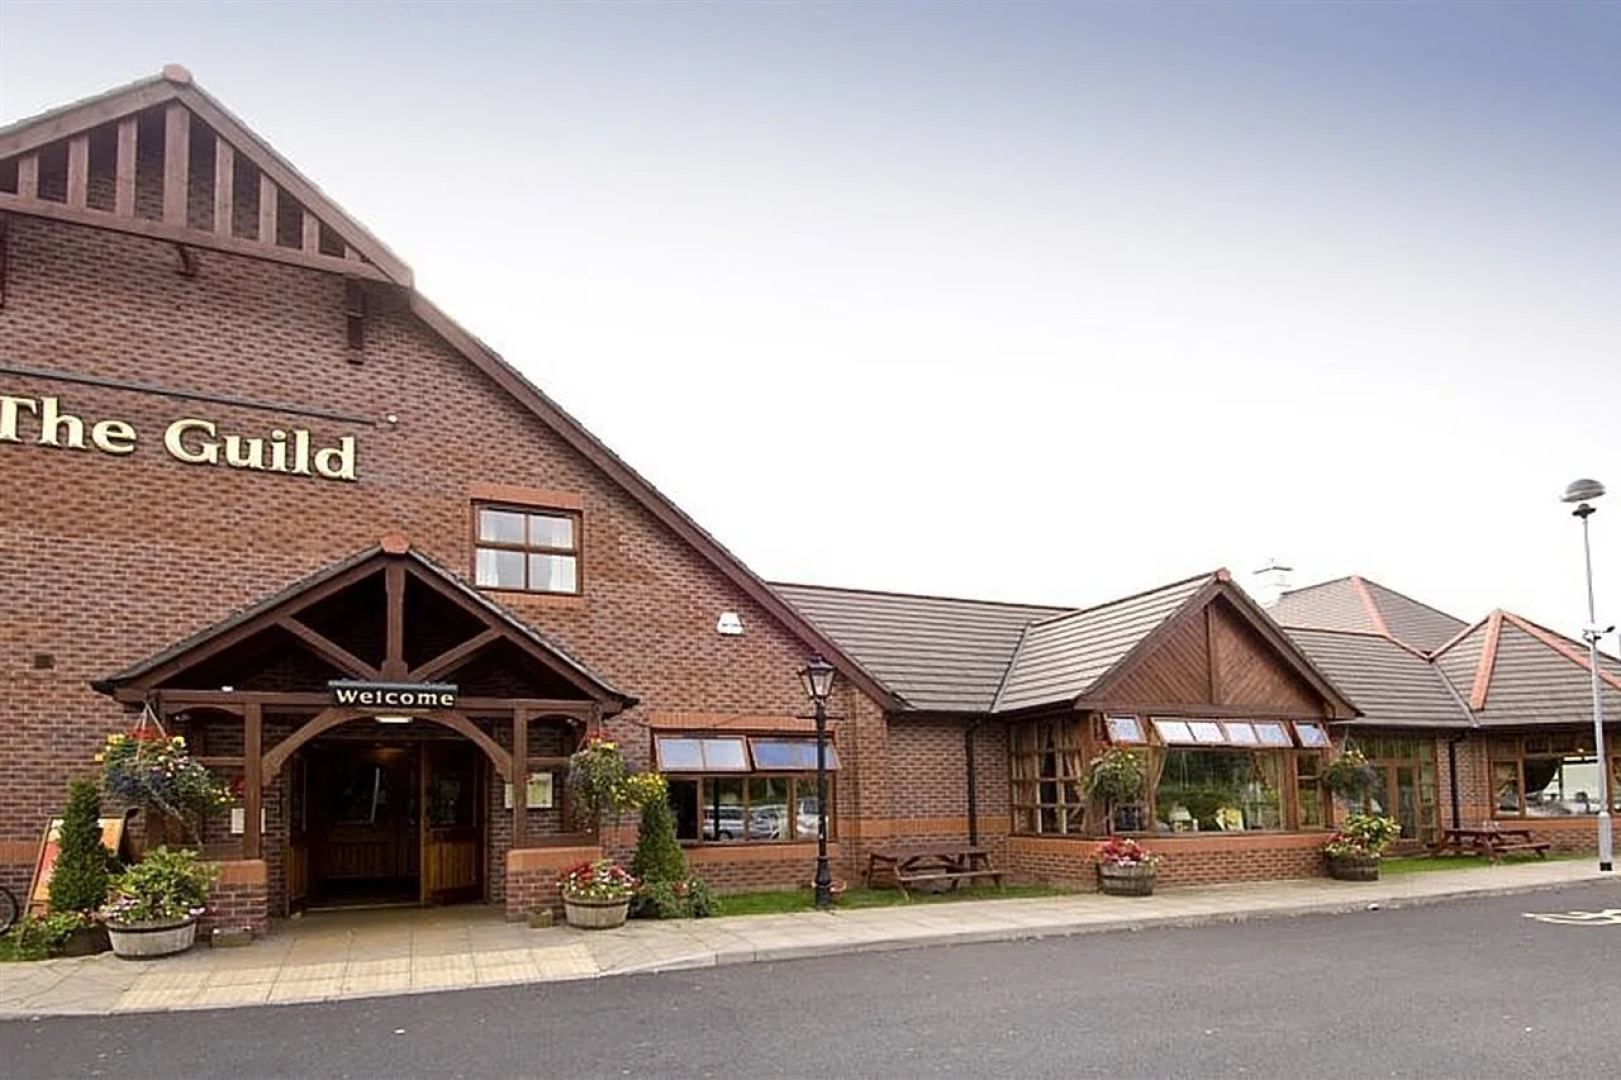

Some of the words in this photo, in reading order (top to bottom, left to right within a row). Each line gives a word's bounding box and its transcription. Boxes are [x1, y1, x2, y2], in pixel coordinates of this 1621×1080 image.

[0, 395, 137, 453] The
[163, 418, 358, 481] Guild
[336, 688, 455, 706] Welcome
